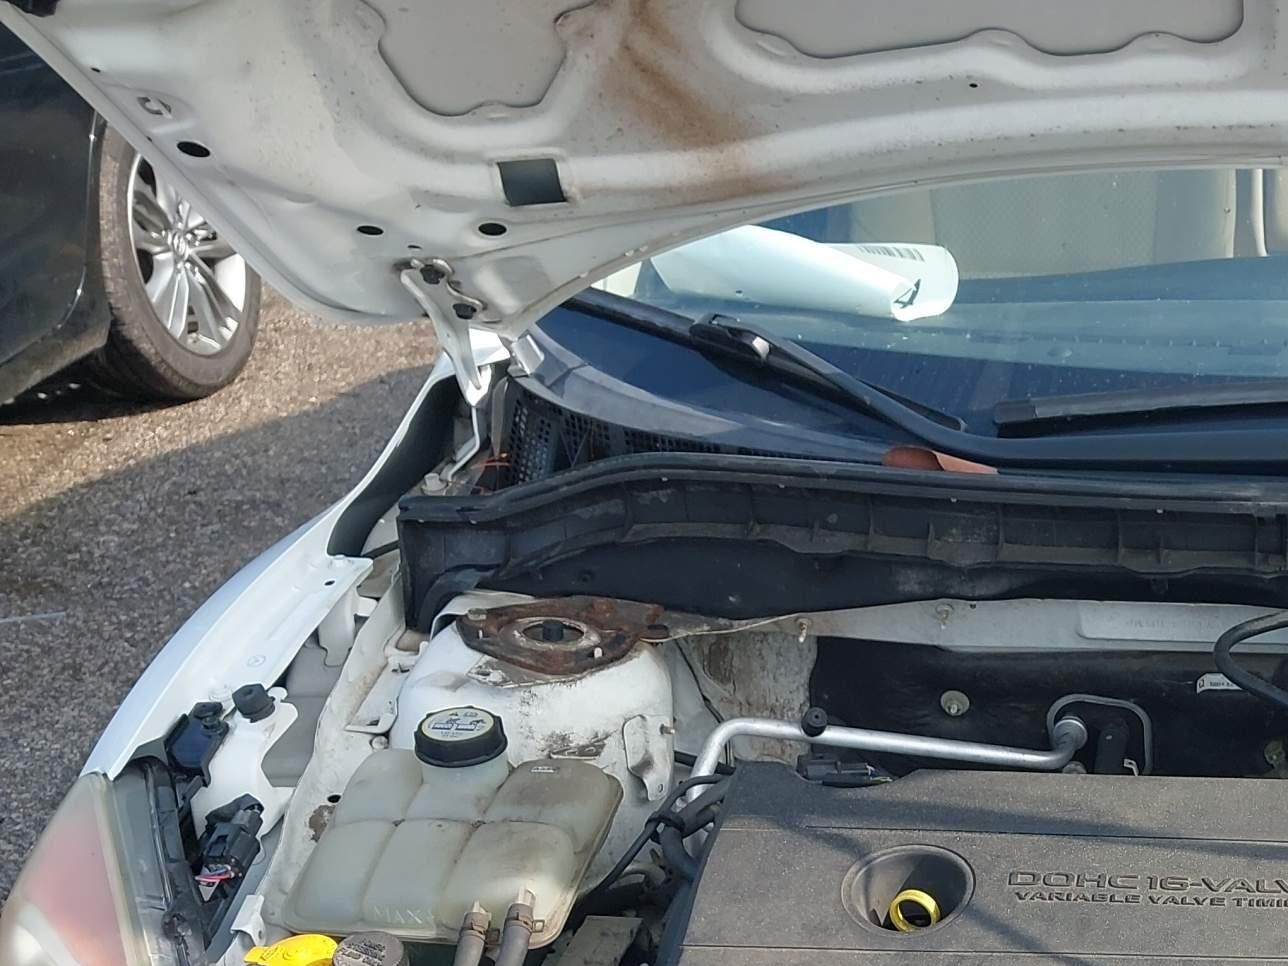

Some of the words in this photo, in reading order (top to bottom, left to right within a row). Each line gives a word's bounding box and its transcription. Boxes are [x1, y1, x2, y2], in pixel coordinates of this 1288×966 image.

[1008, 871, 1138, 890] DOHC
[1015, 891, 1141, 904] VARIABLE
[1148, 895, 1225, 907] VALVE
